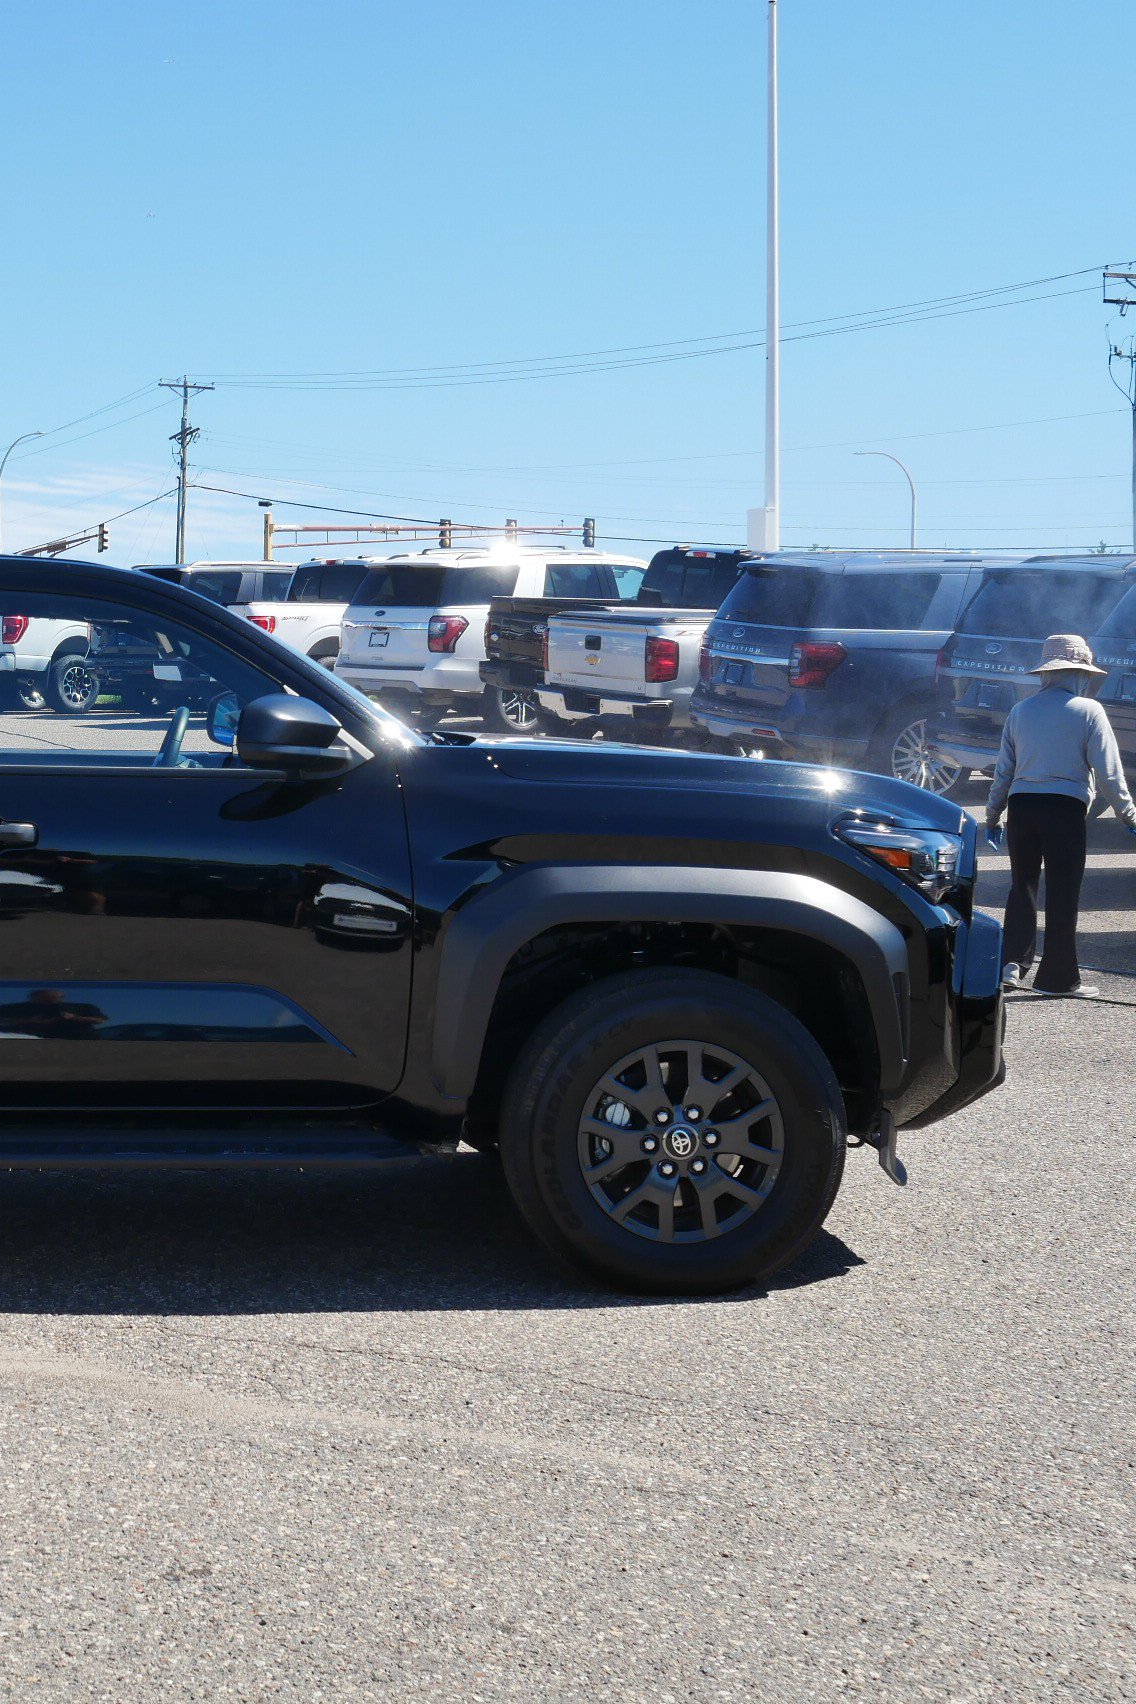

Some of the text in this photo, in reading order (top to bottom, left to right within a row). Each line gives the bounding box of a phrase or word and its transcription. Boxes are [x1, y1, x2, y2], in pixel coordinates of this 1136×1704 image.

[712, 642, 761, 653] EXPEDITION
[957, 660, 1026, 672] EXPEDITION
[539, 1053, 588, 1231] GEOLANDAR
